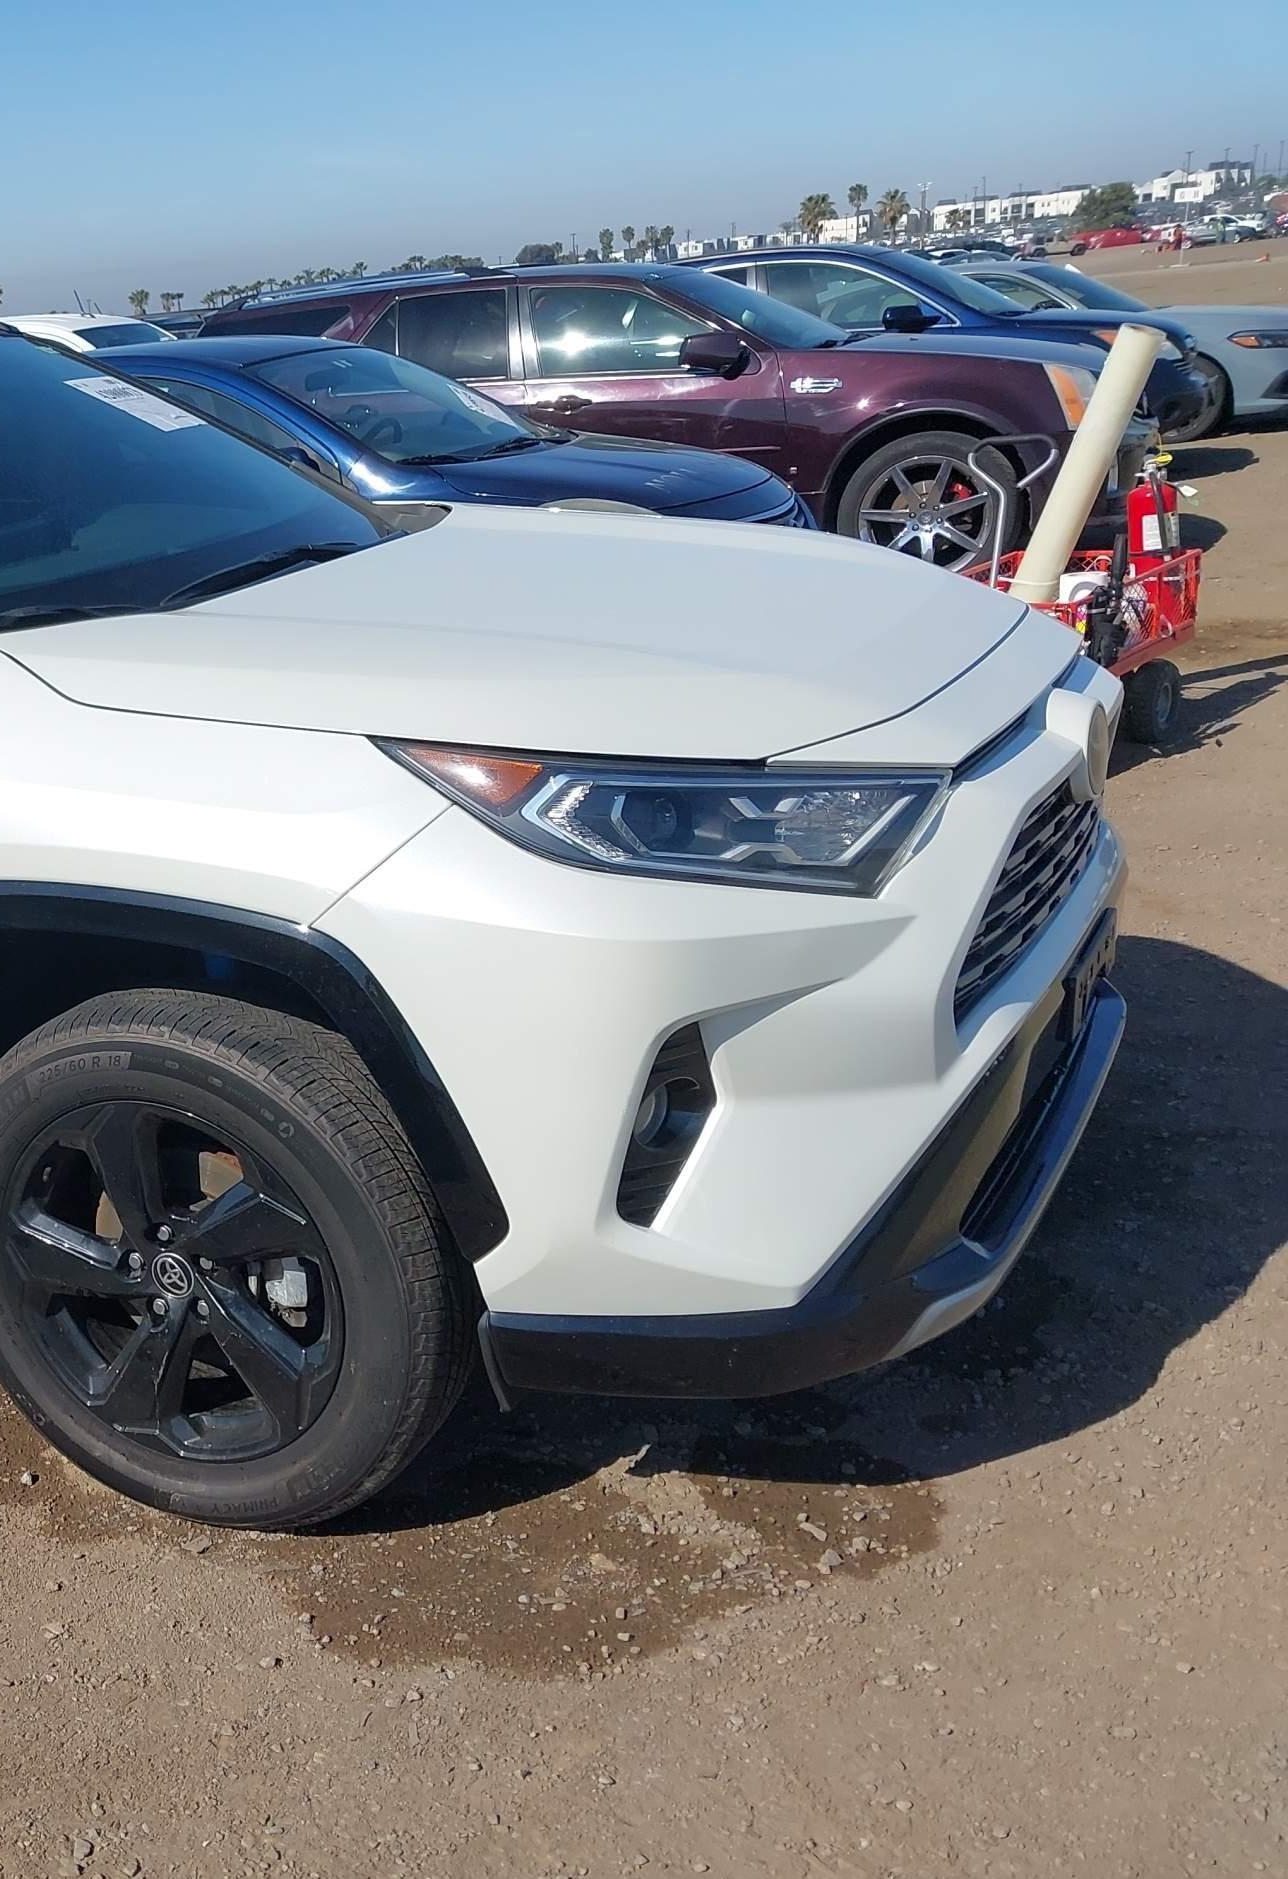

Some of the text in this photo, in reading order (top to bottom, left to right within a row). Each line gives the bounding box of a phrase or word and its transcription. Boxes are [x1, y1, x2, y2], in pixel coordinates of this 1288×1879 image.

[39, 1055, 121, 1082] 225/60 R 18
[213, 1496, 279, 1513] PRIMACY
